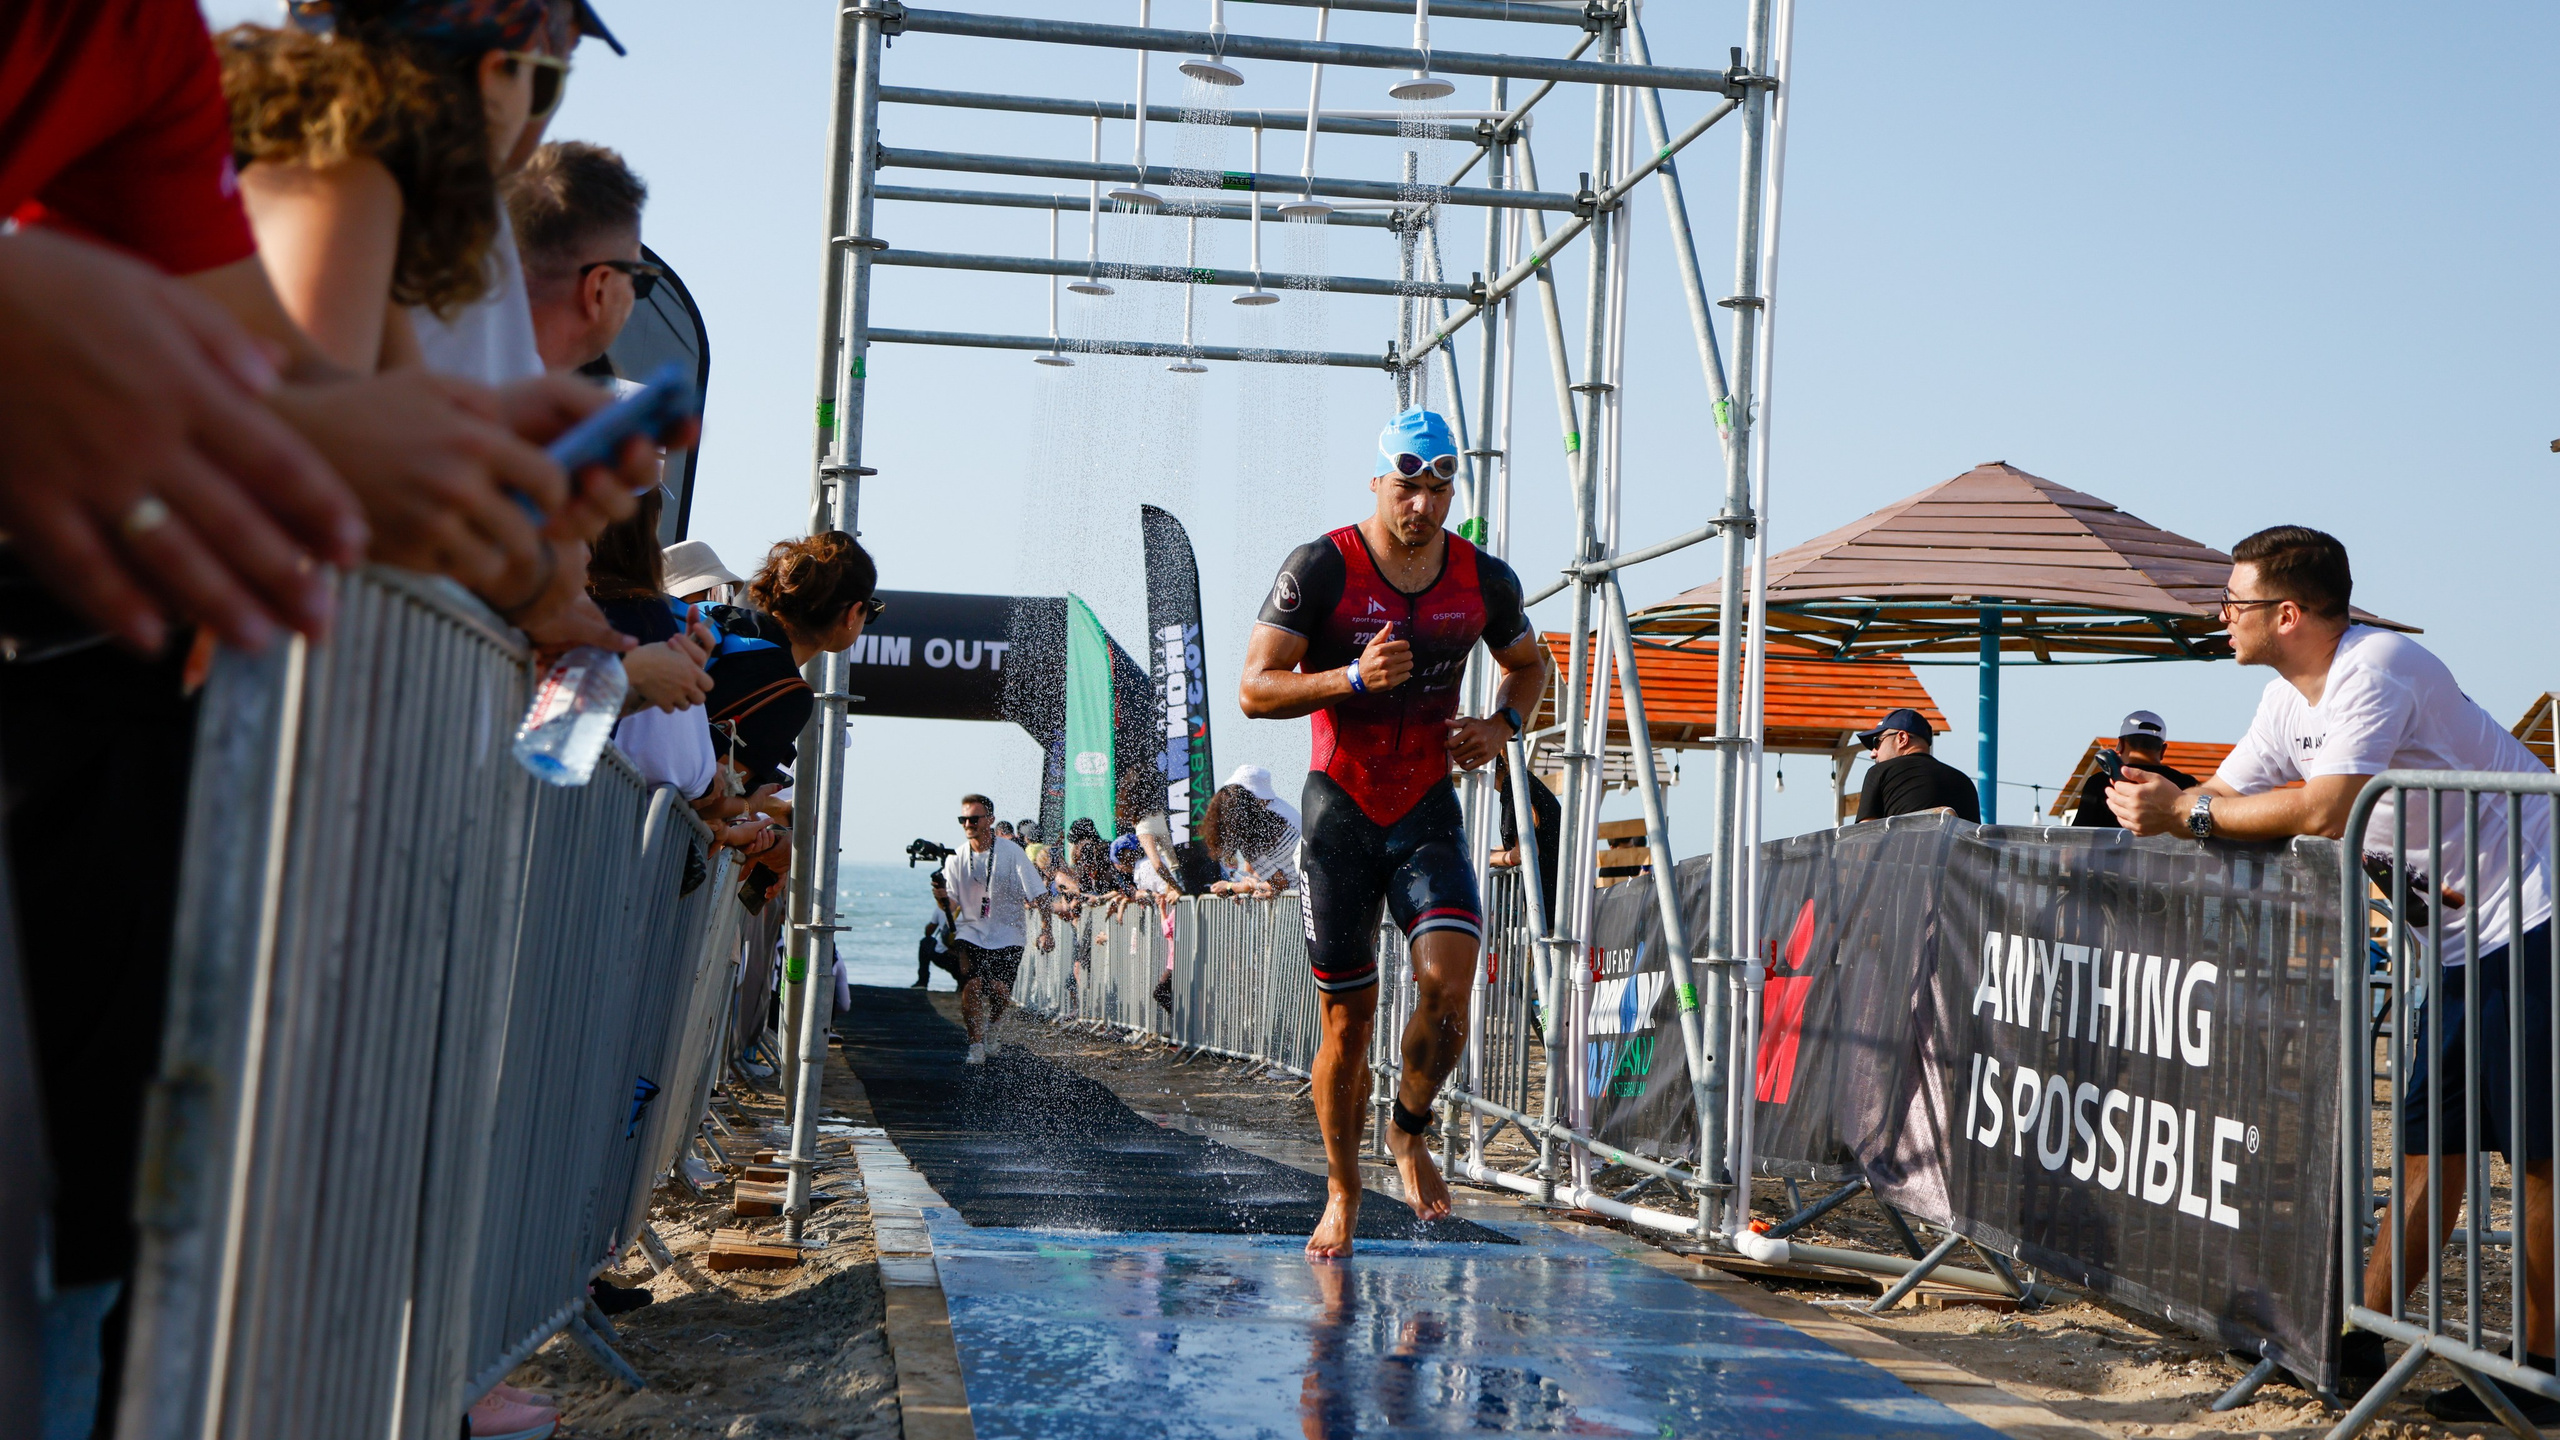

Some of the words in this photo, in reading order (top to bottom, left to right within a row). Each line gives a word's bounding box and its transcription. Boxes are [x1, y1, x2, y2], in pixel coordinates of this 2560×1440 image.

[1432, 612, 1467, 620] GSPORT
[924, 637, 1009, 672] OUT
[1973, 931, 2218, 1067] ANYTHING
[1966, 1052, 2003, 1148] IS
